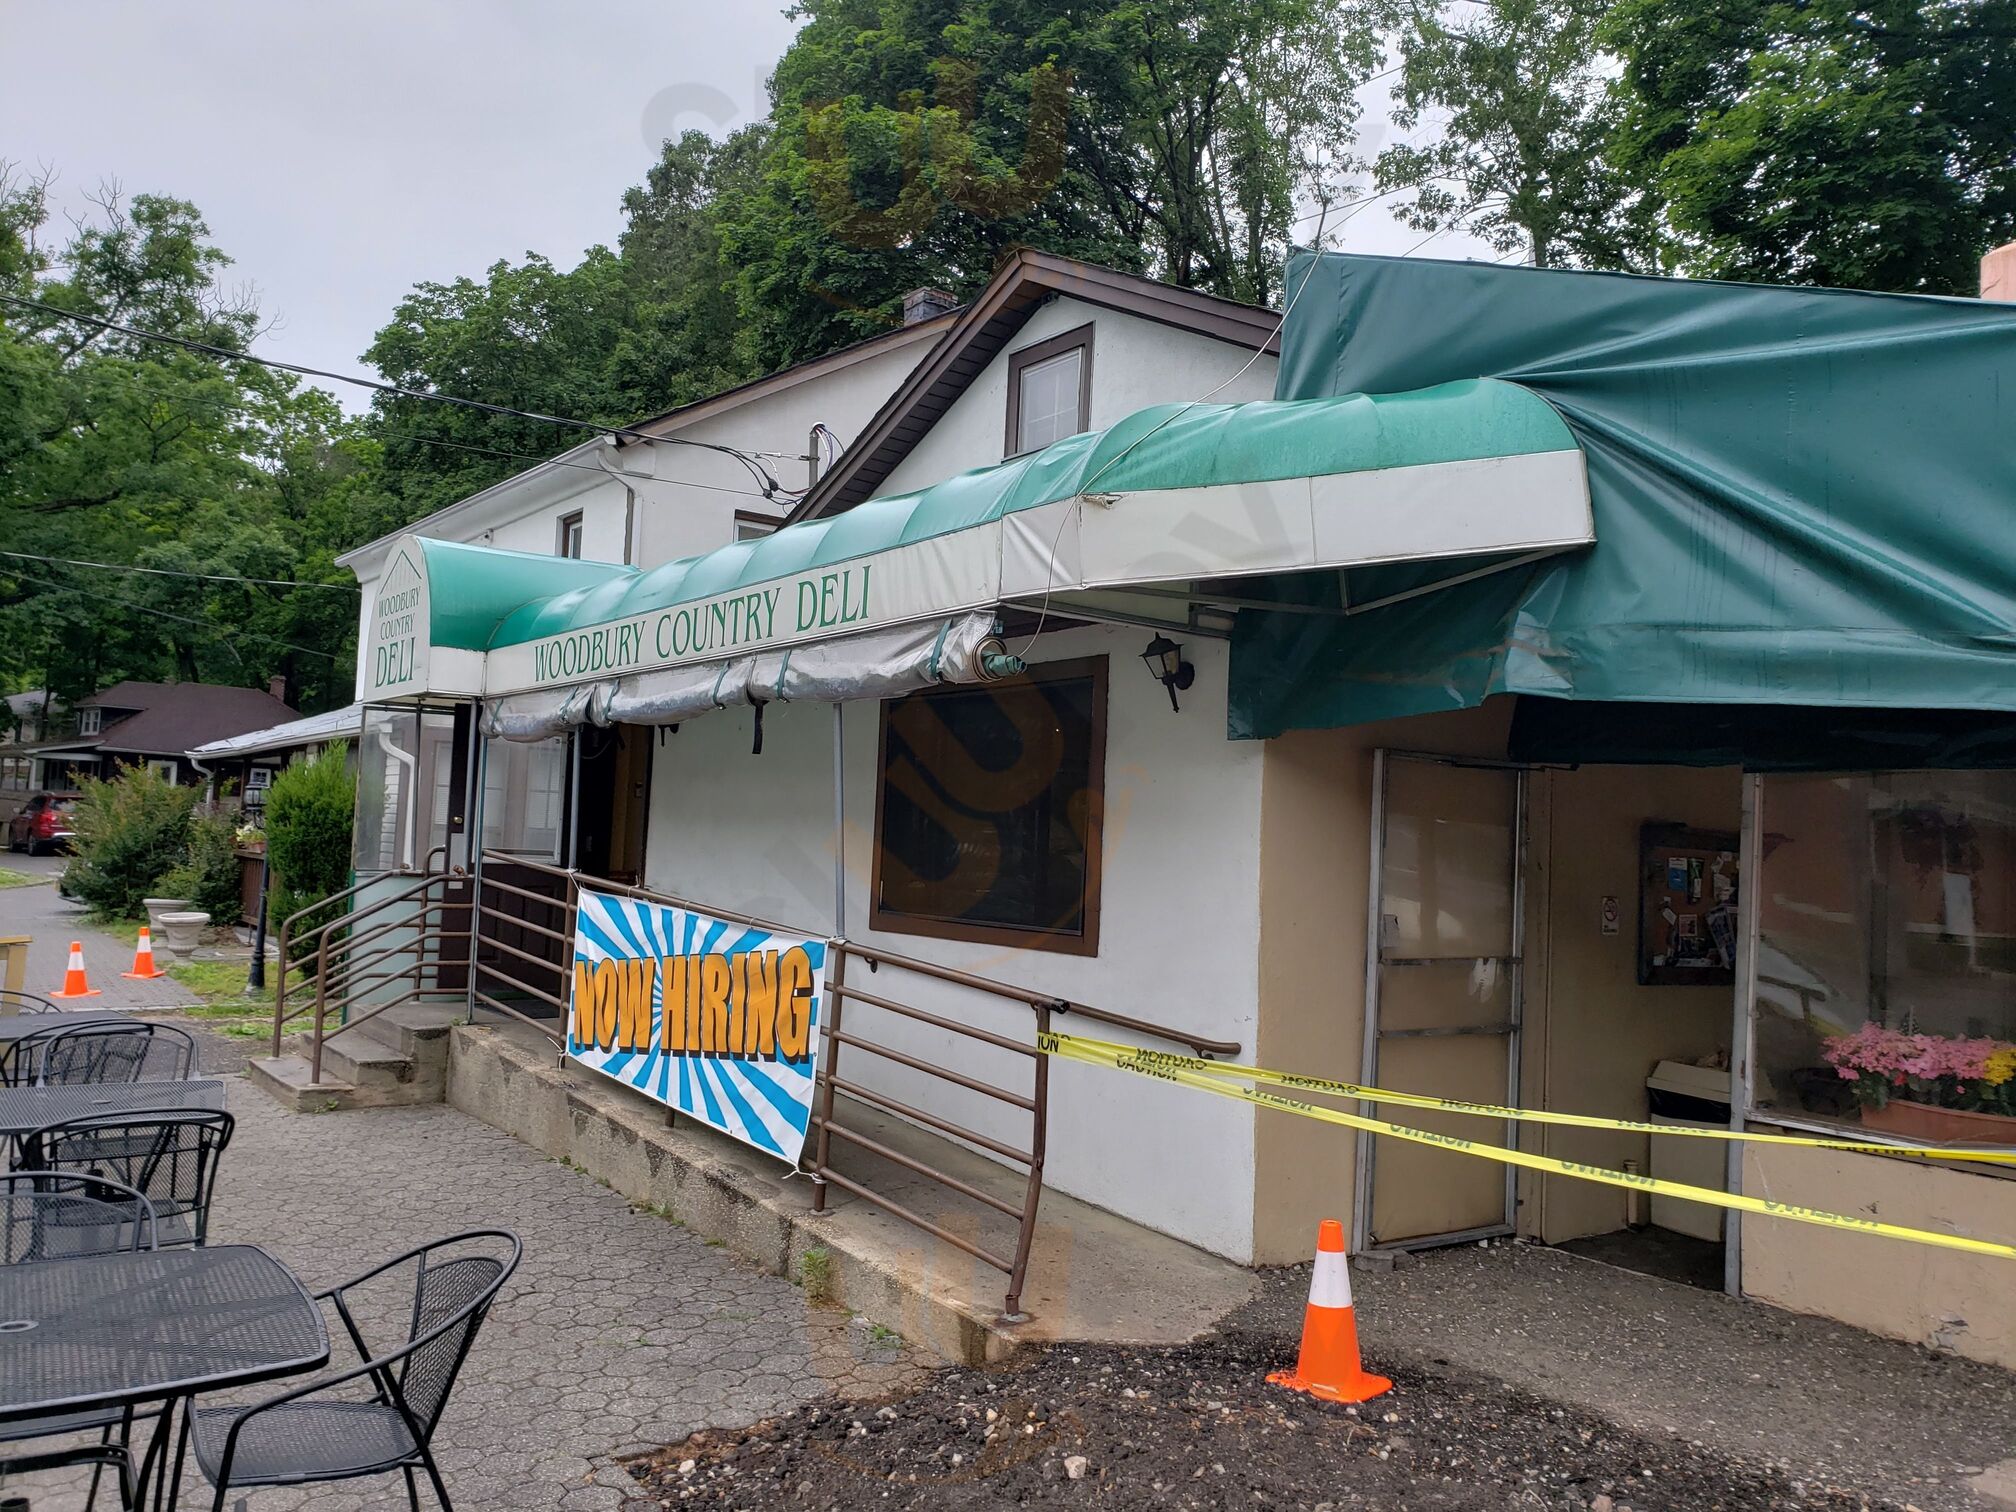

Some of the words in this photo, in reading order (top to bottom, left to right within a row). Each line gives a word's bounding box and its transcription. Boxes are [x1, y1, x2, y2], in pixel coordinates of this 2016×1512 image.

[378, 586, 421, 618] WOODBURY
[380, 613, 415, 641] COUNTRY
[534, 621, 646, 682] WOODBURY
[656, 588, 781, 658] COUNTRY
[796, 565, 871, 632] DELI
[375, 636, 416, 688] DELI
[573, 955, 656, 1054] NOW
[659, 945, 815, 1065] HIRING
